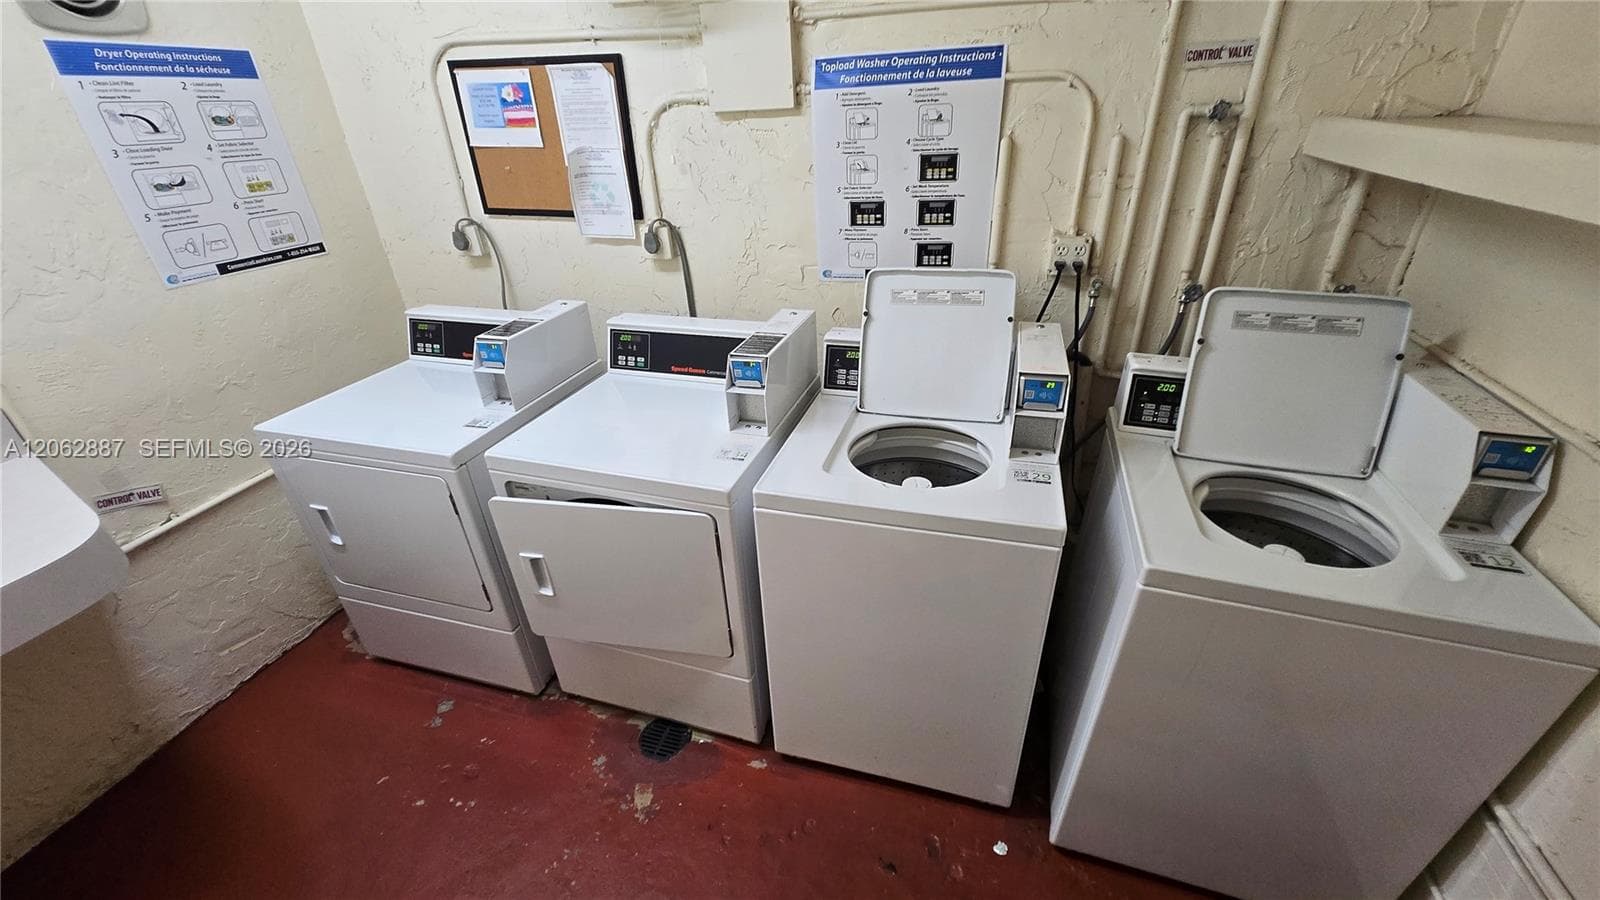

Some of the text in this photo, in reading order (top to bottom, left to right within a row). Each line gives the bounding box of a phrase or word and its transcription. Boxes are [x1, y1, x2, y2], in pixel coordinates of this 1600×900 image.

[94, 48, 222, 62] Dryer Operating Instructions
[1188, 45, 1254, 62] CONTROL VALVE
[820, 50, 996, 74] Topload Washer Operating Instructions
[94, 62, 230, 74] Fonctionnement de la sécheuse
[839, 67, 972, 84] Fonctionnement de la laveuse
[78, 80, 84, 90] 1
[180, 81, 188, 90] 2
[908, 88, 913, 96] 2
[207, 144, 213, 152] 4
[112, 149, 119, 159] 3
[233, 201, 239, 210] 6
[144, 213, 151, 222] 5
[1157, 383, 1176, 392] 2.00
[96, 488, 162, 508] CONTROL VALVE
